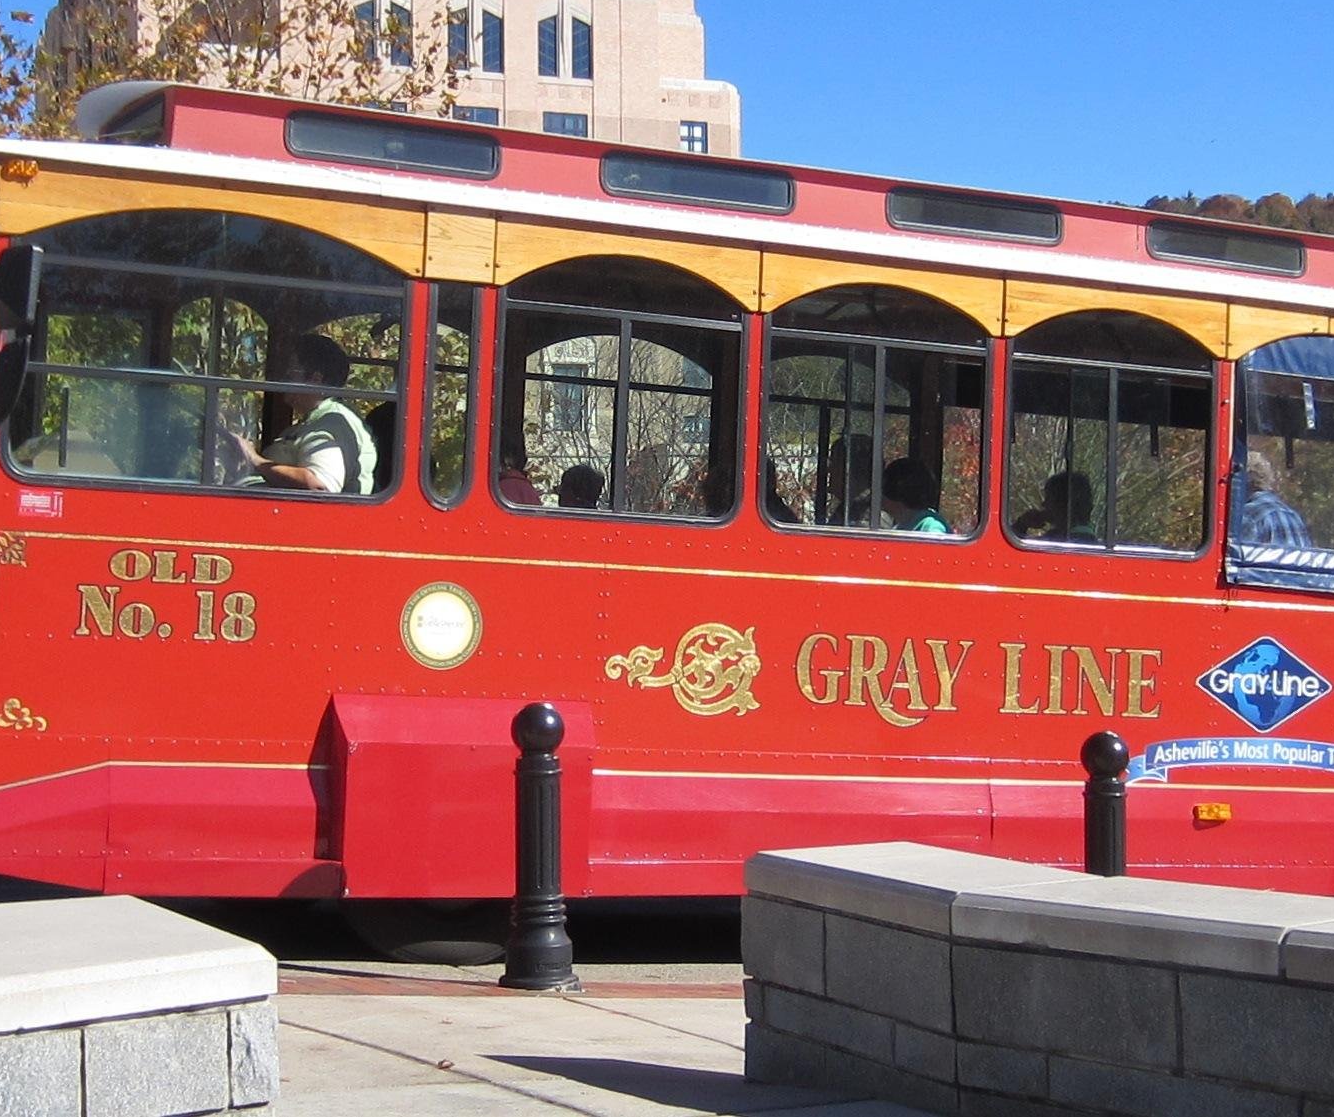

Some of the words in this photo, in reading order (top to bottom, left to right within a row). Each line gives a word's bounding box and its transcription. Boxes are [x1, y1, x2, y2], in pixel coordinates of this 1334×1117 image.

[108, 549, 234, 585] OLD
[74, 584, 173, 639] No.
[193, 590, 257, 643] 18
[795, 632, 974, 728] GRAY
[999, 641, 1163, 718] LINE
[1153, 741, 1230, 763] Asheville's
[1233, 741, 1269, 760] Most
[1273, 742, 1326, 765] Popular
